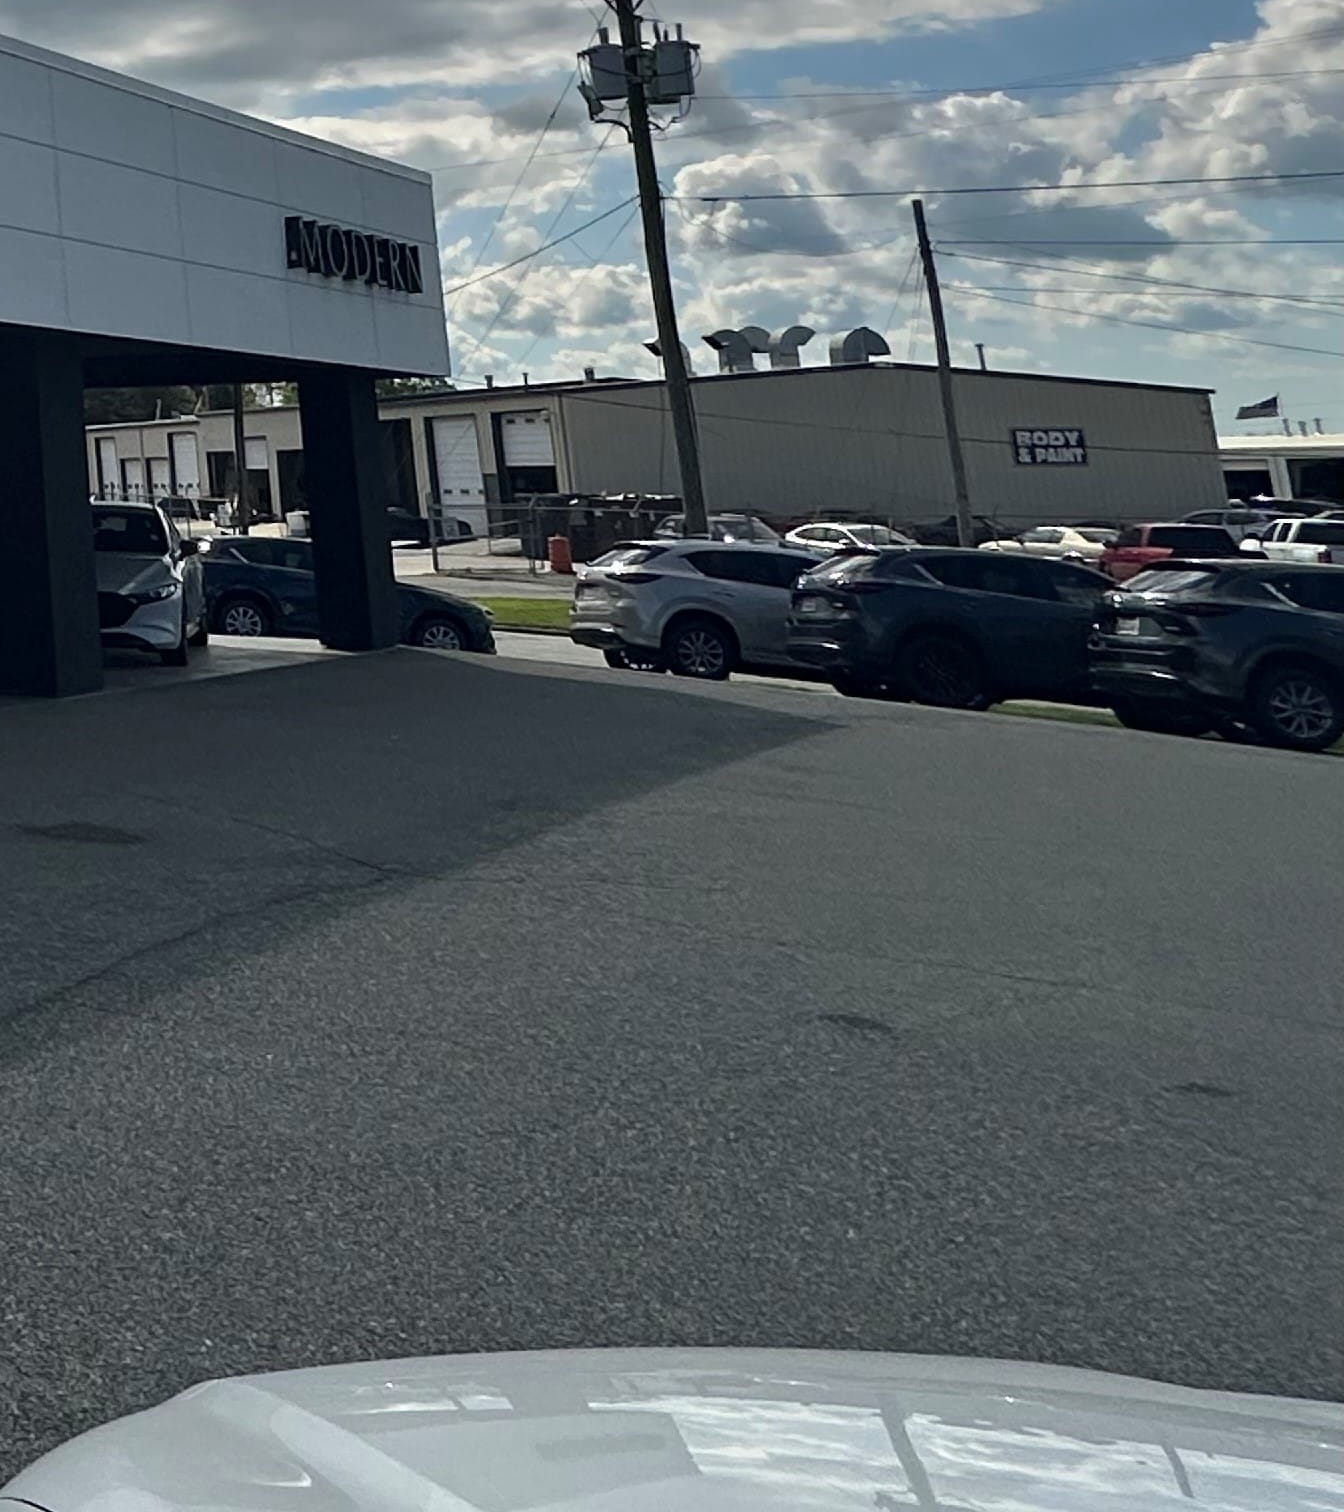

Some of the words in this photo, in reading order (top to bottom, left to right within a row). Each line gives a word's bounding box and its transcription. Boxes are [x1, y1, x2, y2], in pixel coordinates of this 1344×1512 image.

[299, 220, 424, 293] MODERN
[1015, 430, 1080, 446] BODY
[1018, 447, 1032, 464] &
[1035, 447, 1084, 464] PAINT
